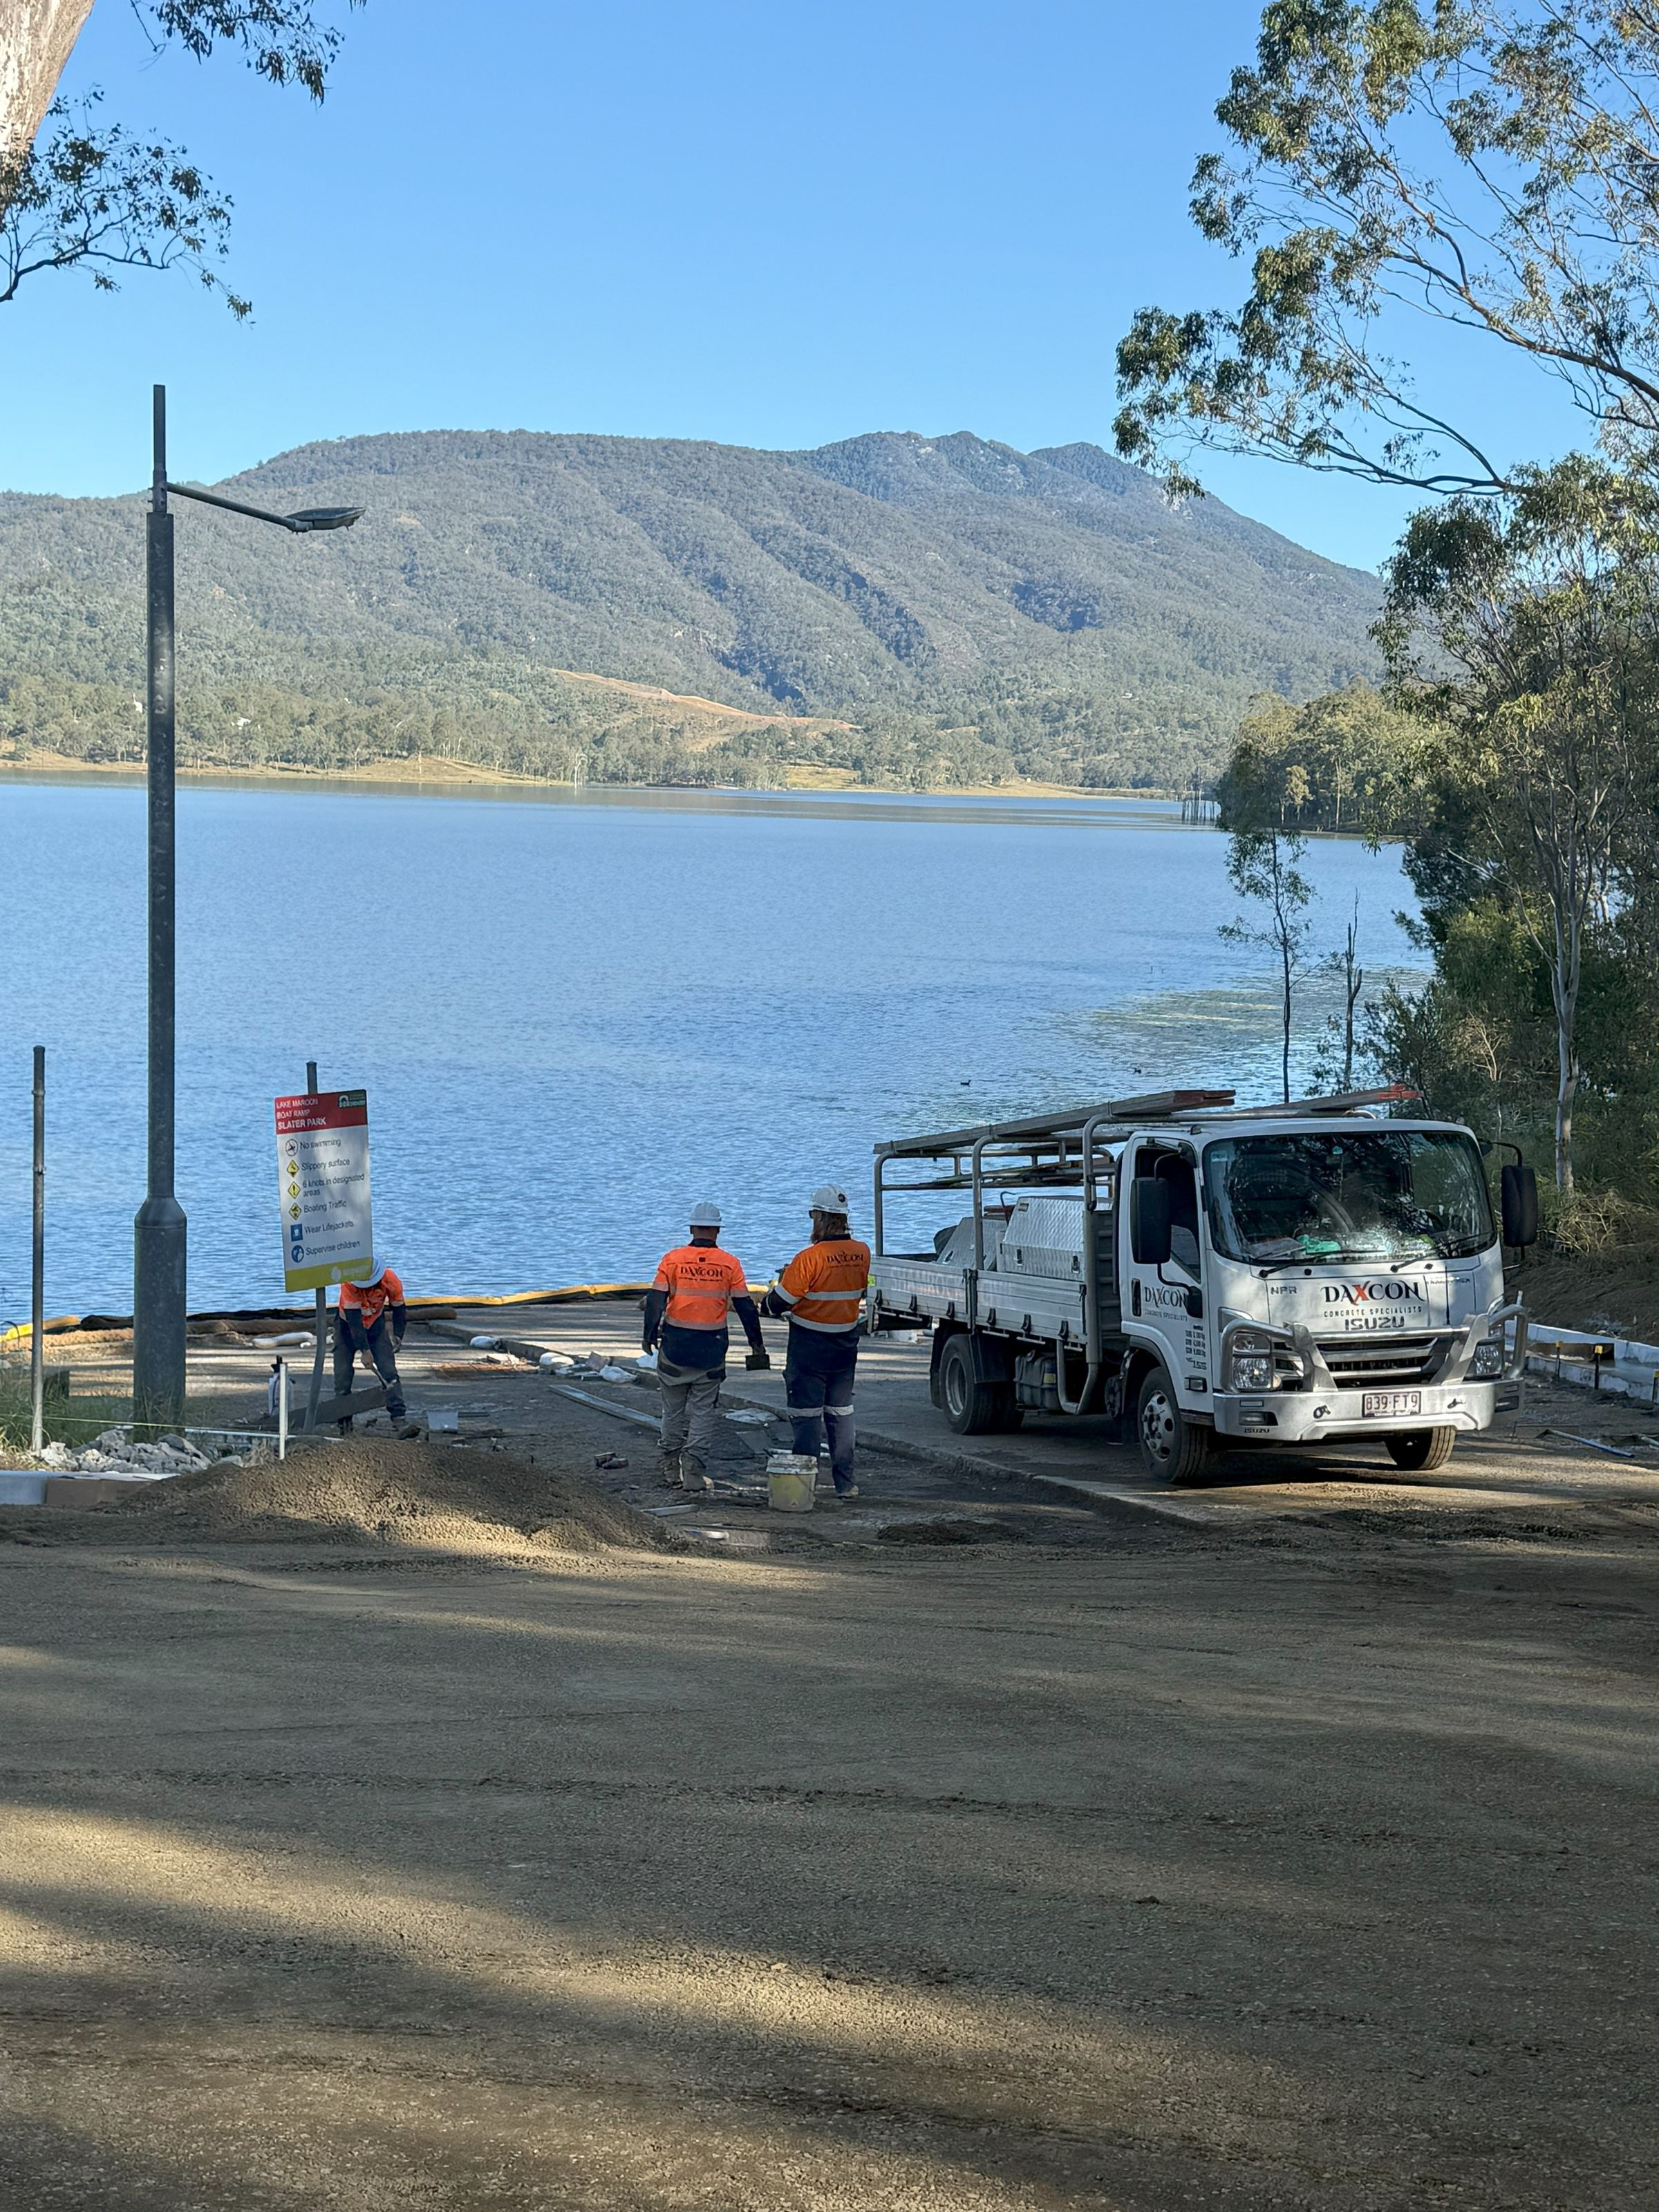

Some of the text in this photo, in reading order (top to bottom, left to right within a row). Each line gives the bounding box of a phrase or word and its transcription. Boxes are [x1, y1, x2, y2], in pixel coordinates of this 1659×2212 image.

[276, 1100, 291, 1109] LAKE
[276, 1109, 310, 1119] BOAT RAMP
[277, 1116, 326, 1130] SLATER PARK
[301, 1159, 350, 1171] Slippery surface
[303, 1188, 321, 1197] areas
[303, 1200, 347, 1213] Boating Traffic
[304, 1226, 321, 1235] Wear
[306, 1240, 360, 1256] Supervise children
[1271, 1286, 1297, 1295] NPR
[1320, 1280, 1425, 1306] DAXCON
[1324, 1306, 1423, 1318] CONCRETE SPECIALISTS
[1344, 1315, 1405, 1331] ISUZU
